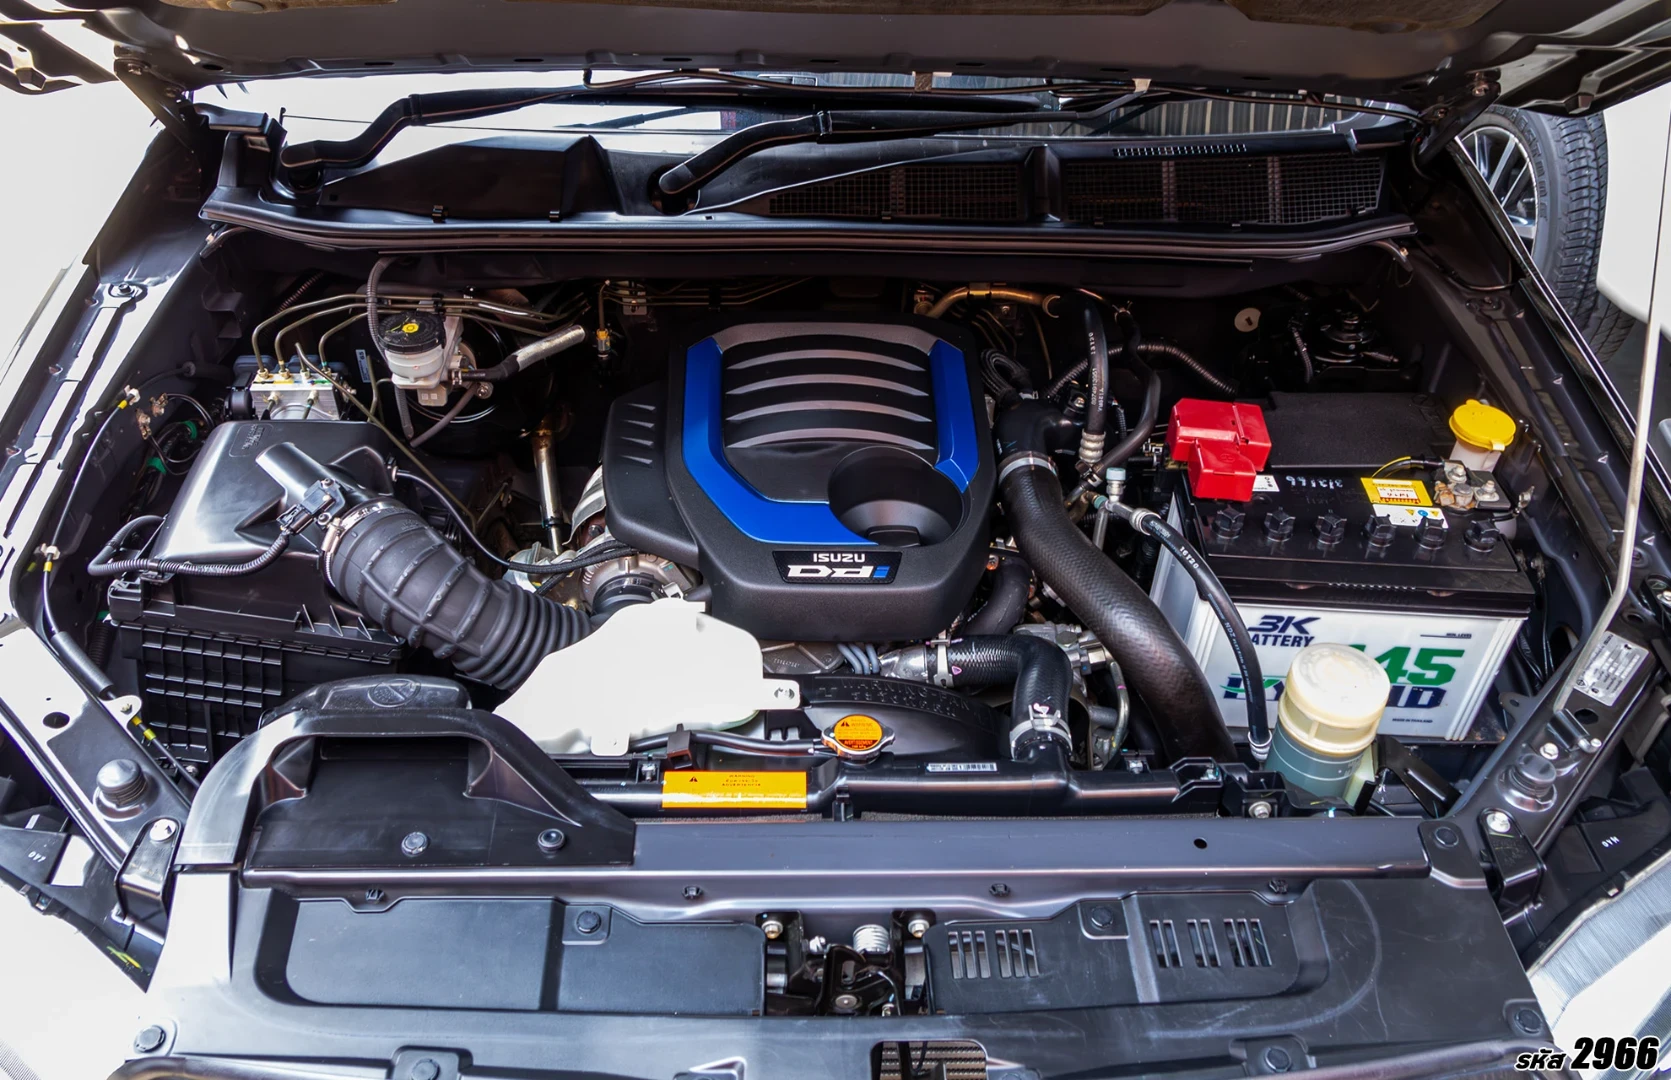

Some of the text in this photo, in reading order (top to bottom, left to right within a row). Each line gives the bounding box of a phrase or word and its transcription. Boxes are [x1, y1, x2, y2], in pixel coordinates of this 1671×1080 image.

[813, 553, 866, 563] ISUZU
[1248, 615, 1321, 635] 3K
[1251, 634, 1315, 648] ATTERY
